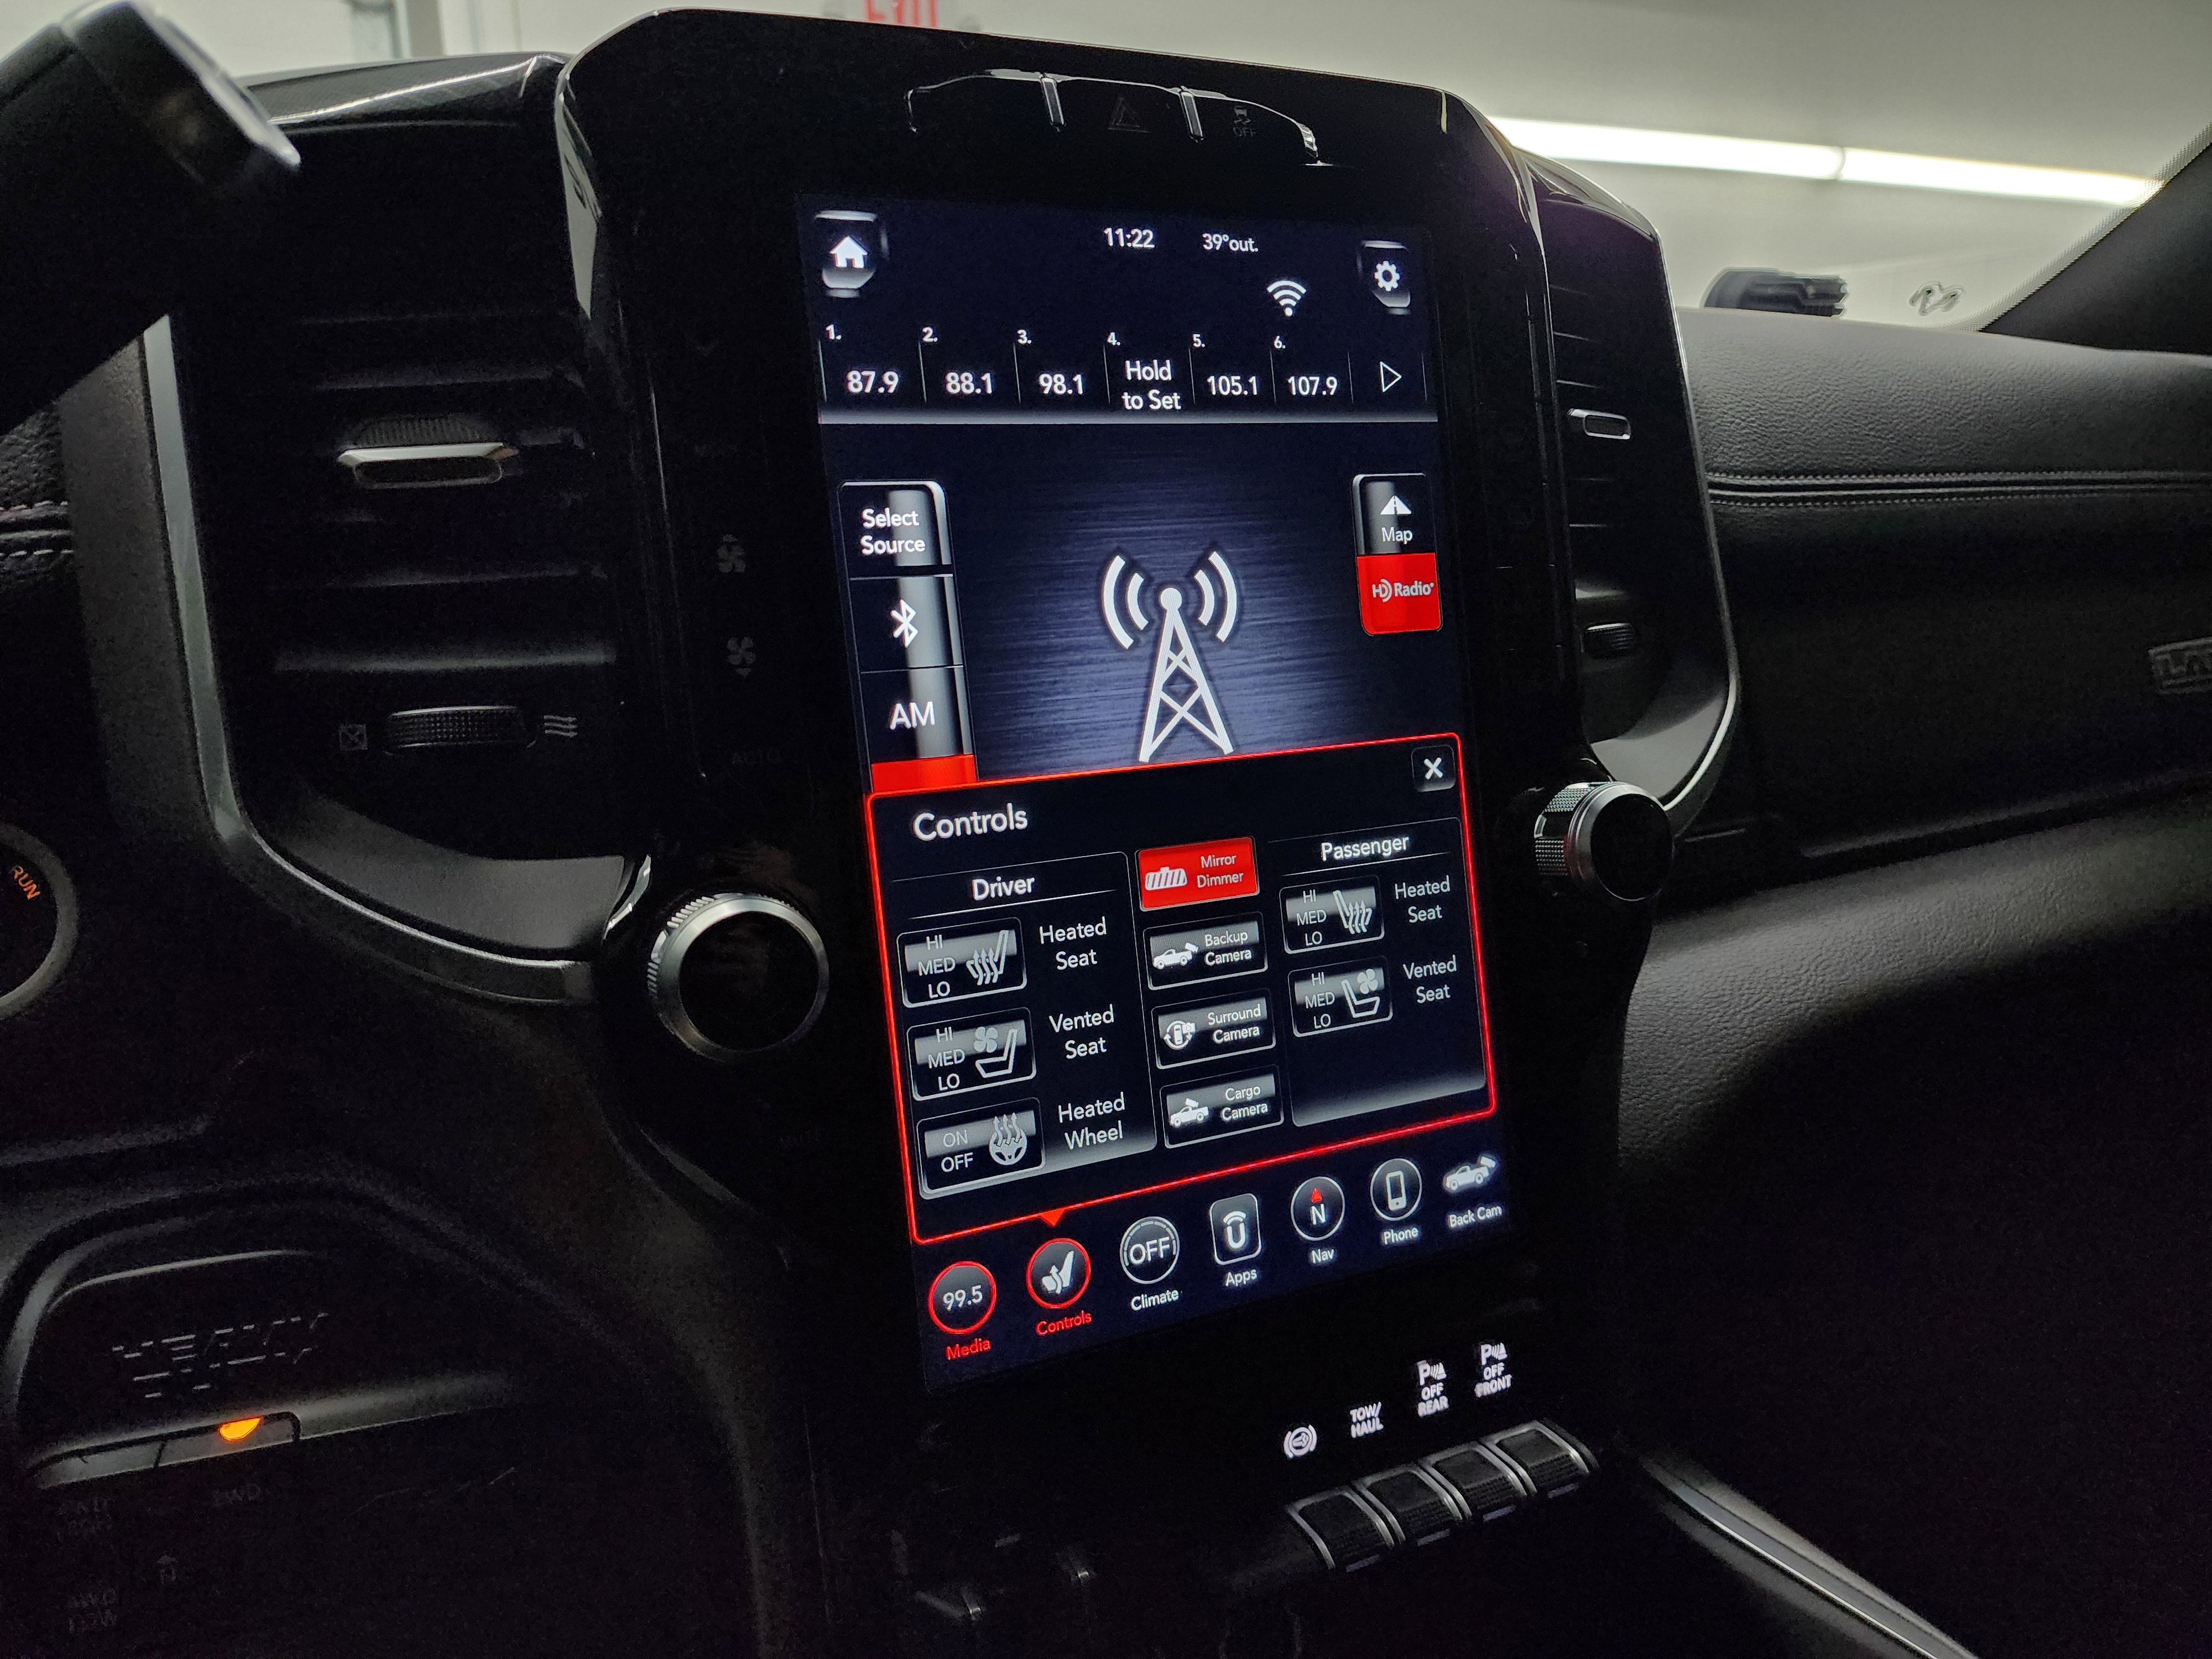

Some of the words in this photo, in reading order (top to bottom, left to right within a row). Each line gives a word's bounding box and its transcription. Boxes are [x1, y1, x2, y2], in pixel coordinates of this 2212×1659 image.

[1104, 227, 1155, 249] 11:22
[825, 324, 842, 340] 1.
[921, 327, 938, 343] 2.
[1017, 329, 1032, 345] 3.
[1107, 332, 1121, 347] 4.
[1192, 333, 1206, 348] 5.
[1274, 335, 1286, 349] 6.
[1125, 360, 1172, 381] Hold
[846, 371, 899, 393] 87.9
[946, 372, 993, 394] 88.1
[1039, 373, 1084, 395] 98.1
[1207, 375, 1258, 395] 105.1
[1287, 376, 1338, 396] 107.9
[1122, 392, 1144, 410] to
[1148, 389, 1181, 410] Set
[862, 507, 920, 528] Select
[860, 535, 926, 555] Source
[1382, 527, 1413, 544] Map
[889, 701, 935, 731] AM
[914, 802, 1028, 841] Controls
[1321, 836, 1410, 862] Passenger
[1200, 854, 1237, 869] Mirror
[11, 864, 41, 900] RUN
[972, 876, 1035, 901] Driver
[1197, 872, 1244, 888] Dimmer
[1394, 874, 1451, 900] Heated
[1302, 889, 1317, 903] HI
[1296, 909, 1327, 926] MED
[1407, 904, 1443, 924] Seat
[1039, 916, 1107, 945] Heated
[1204, 930, 1249, 947] Backup
[1305, 931, 1323, 947] LO
[926, 934, 943, 951] HI
[917, 956, 956, 977] MED
[1055, 948, 1098, 971] Seat
[1204, 948, 1252, 967] Camera
[1402, 954, 1458, 980] Vented
[1311, 971, 1325, 986] HI
[928, 980, 951, 999] LO
[1416, 984, 1452, 1004] Seat
[1305, 991, 1335, 1009] MED
[1048, 1004, 1115, 1033] Vented
[1208, 1003, 1261, 1026] Surround
[1313, 1013, 1332, 1030] LO
[936, 1026, 953, 1044] HI
[1212, 1025, 1260, 1044] Camera
[1065, 1037, 1107, 1059] Seat
[928, 1048, 966, 1069] MED
[938, 1073, 961, 1091] LO
[1225, 1085, 1261, 1102] Cargo
[1058, 1092, 1125, 1123] Heated
[1220, 1103, 1269, 1122] Camera
[943, 1129, 968, 1148] ON
[1064, 1120, 1124, 1150] Wheel
[941, 1152, 973, 1172] OFF
[1310, 1203, 1326, 1225] N
[1448, 1212, 1475, 1228] Back
[1477, 1205, 1503, 1220] Cam
[1384, 1225, 1419, 1245] Phone
[1129, 1235, 1171, 1266] OFF
[1311, 1248, 1334, 1264] Nav
[1224, 1267, 1258, 1287] Apps
[943, 1285, 983, 1312] 99.5
[1130, 1288, 1180, 1311] Climate
[1036, 1310, 1092, 1337] Controls
[946, 1338, 992, 1361] Media
[1483, 1362, 1505, 1380] OFF
[1421, 1383, 1444, 1400] OFF
[1474, 1374, 1512, 1398] FRONT
[1349, 1401, 1382, 1422] TOW/
[1417, 1395, 1449, 1417] REAR
[1350, 1417, 1384, 1438] HAUL
